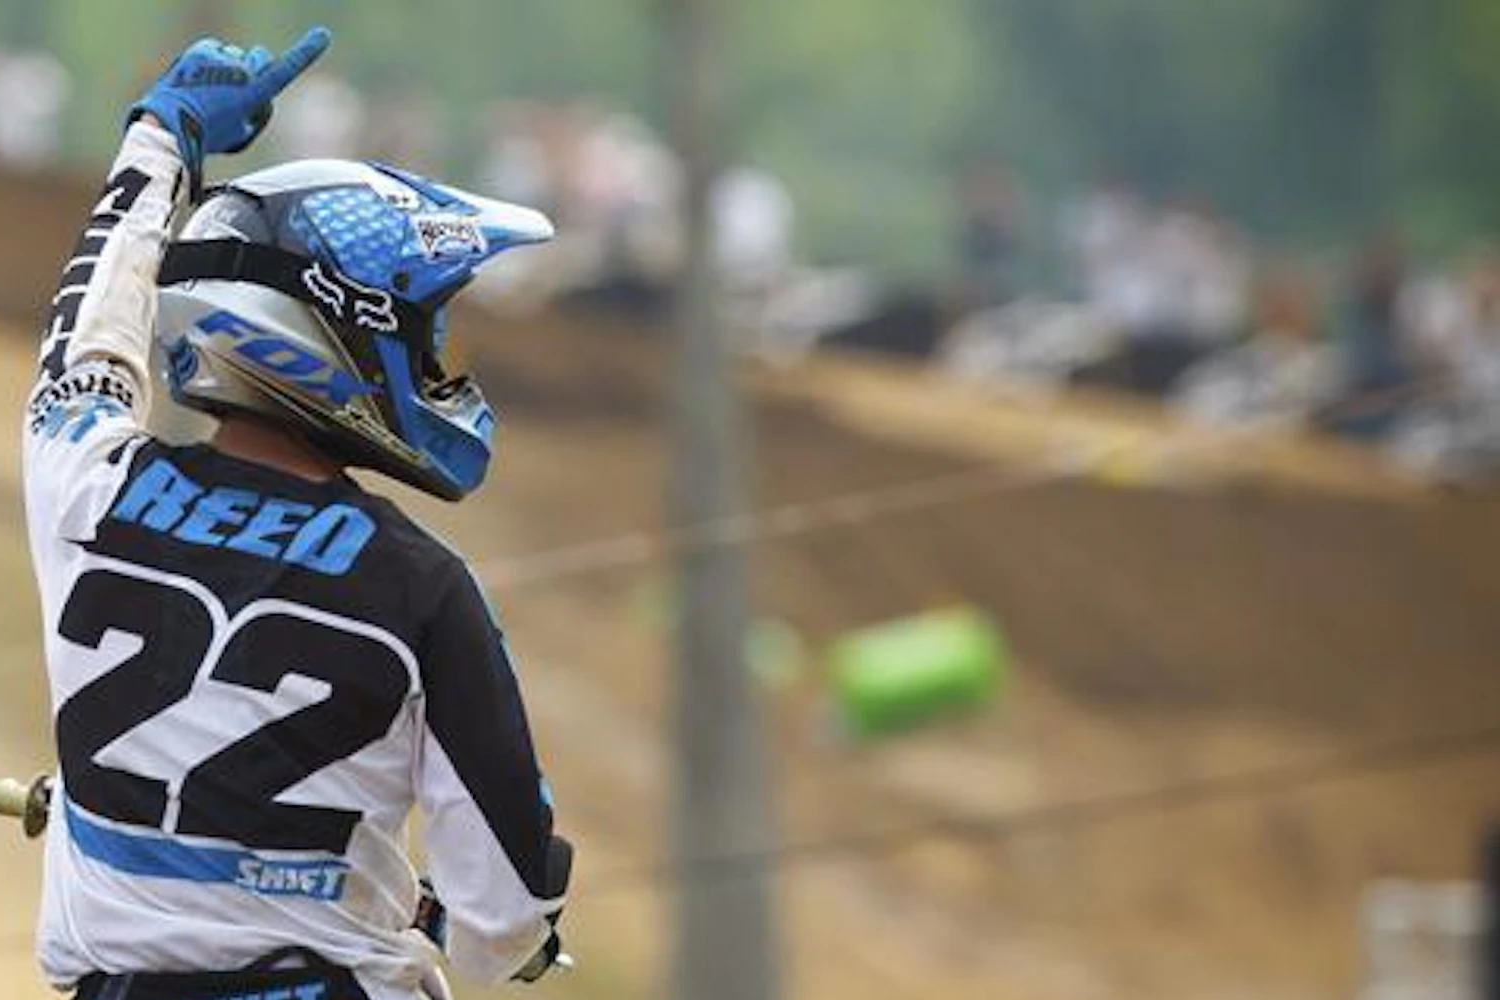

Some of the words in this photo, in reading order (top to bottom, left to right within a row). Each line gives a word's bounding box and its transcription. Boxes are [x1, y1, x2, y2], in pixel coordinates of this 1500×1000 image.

[196, 310, 382, 403] FOX
[111, 459, 377, 575] REED
[56, 567, 411, 855] 22
[235, 859, 345, 898] SHIFT
